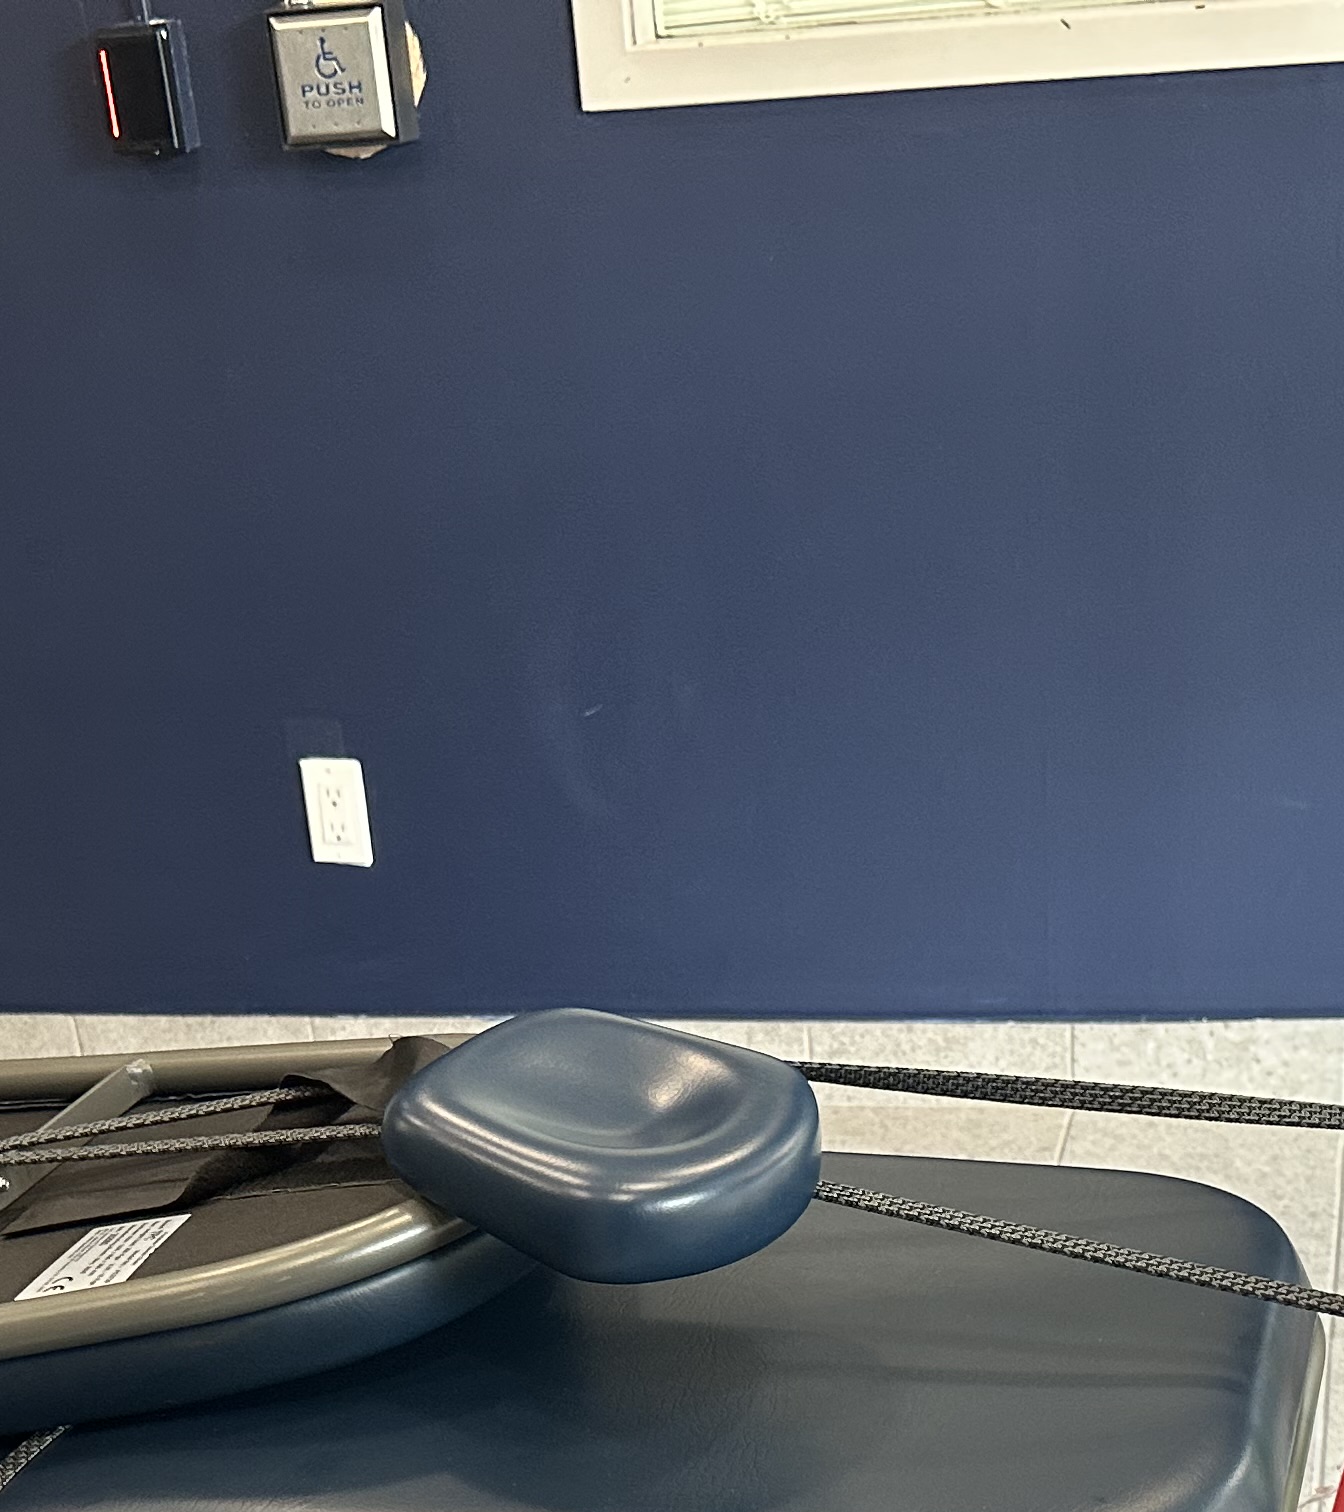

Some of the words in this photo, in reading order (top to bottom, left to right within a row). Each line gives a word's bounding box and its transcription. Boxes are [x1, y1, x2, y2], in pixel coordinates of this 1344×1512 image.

[301, 80, 362, 98] PUSH
[303, 100, 322, 110] TO
[327, 97, 365, 108] OPEN
